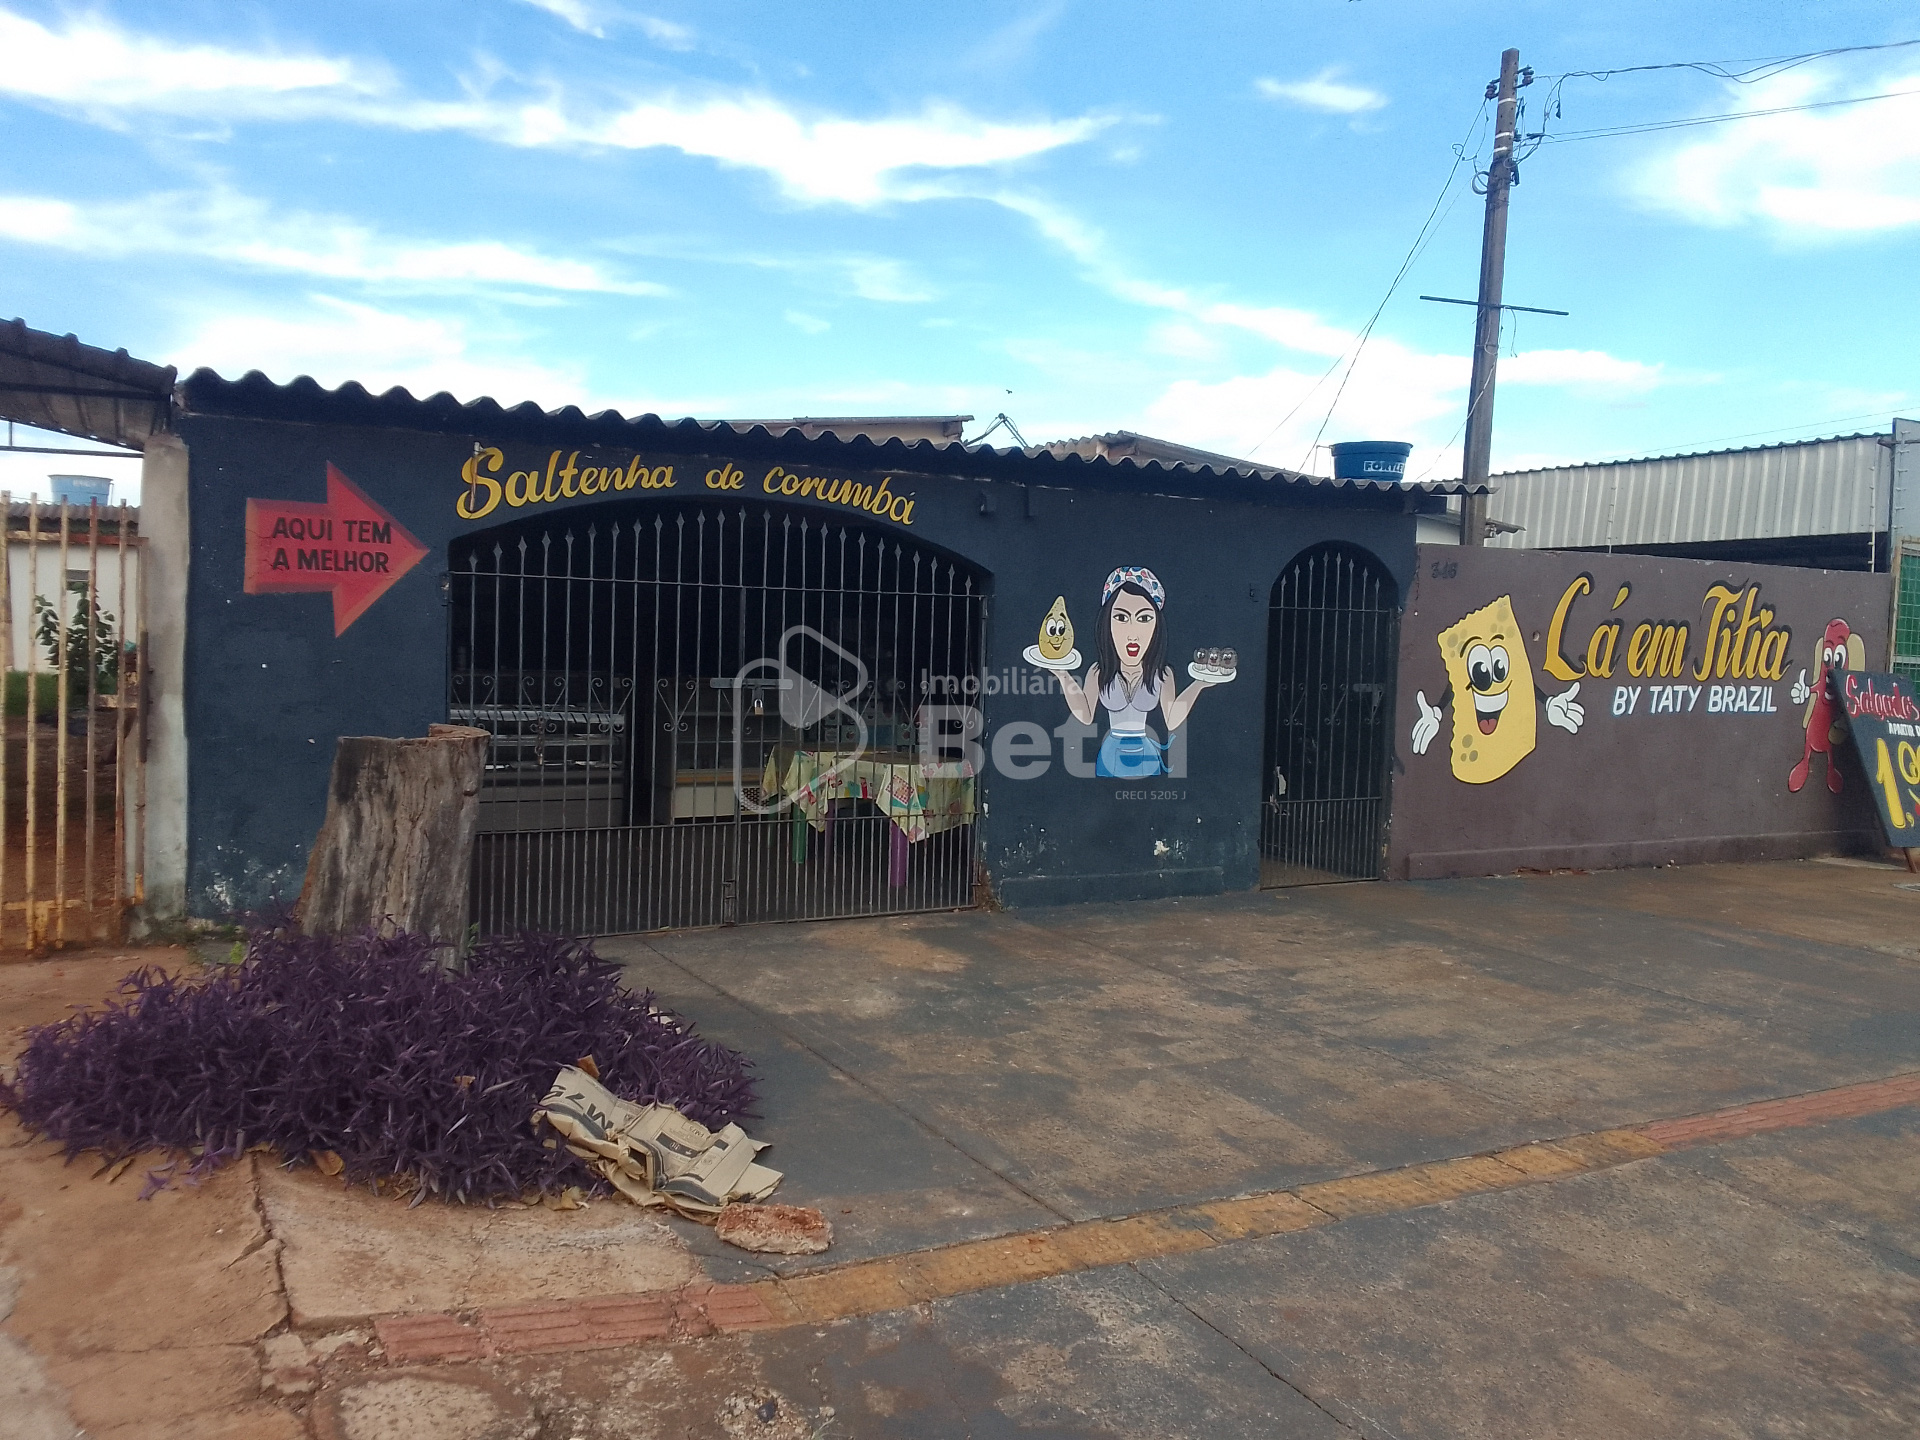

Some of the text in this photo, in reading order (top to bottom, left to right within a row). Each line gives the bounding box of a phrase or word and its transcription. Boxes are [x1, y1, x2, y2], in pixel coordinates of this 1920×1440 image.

[1363, 460, 1405, 474] FORTLE
[456, 446, 915, 525] Saltenha de Corumbá
[273, 517, 392, 544] AQUI TEM
[272, 547, 390, 573] A MELHOR
[1627, 623, 1687, 678] em
[1693, 584, 1793, 681] Titia
[1612, 685, 1778, 716] BY TATY BRAZIL
